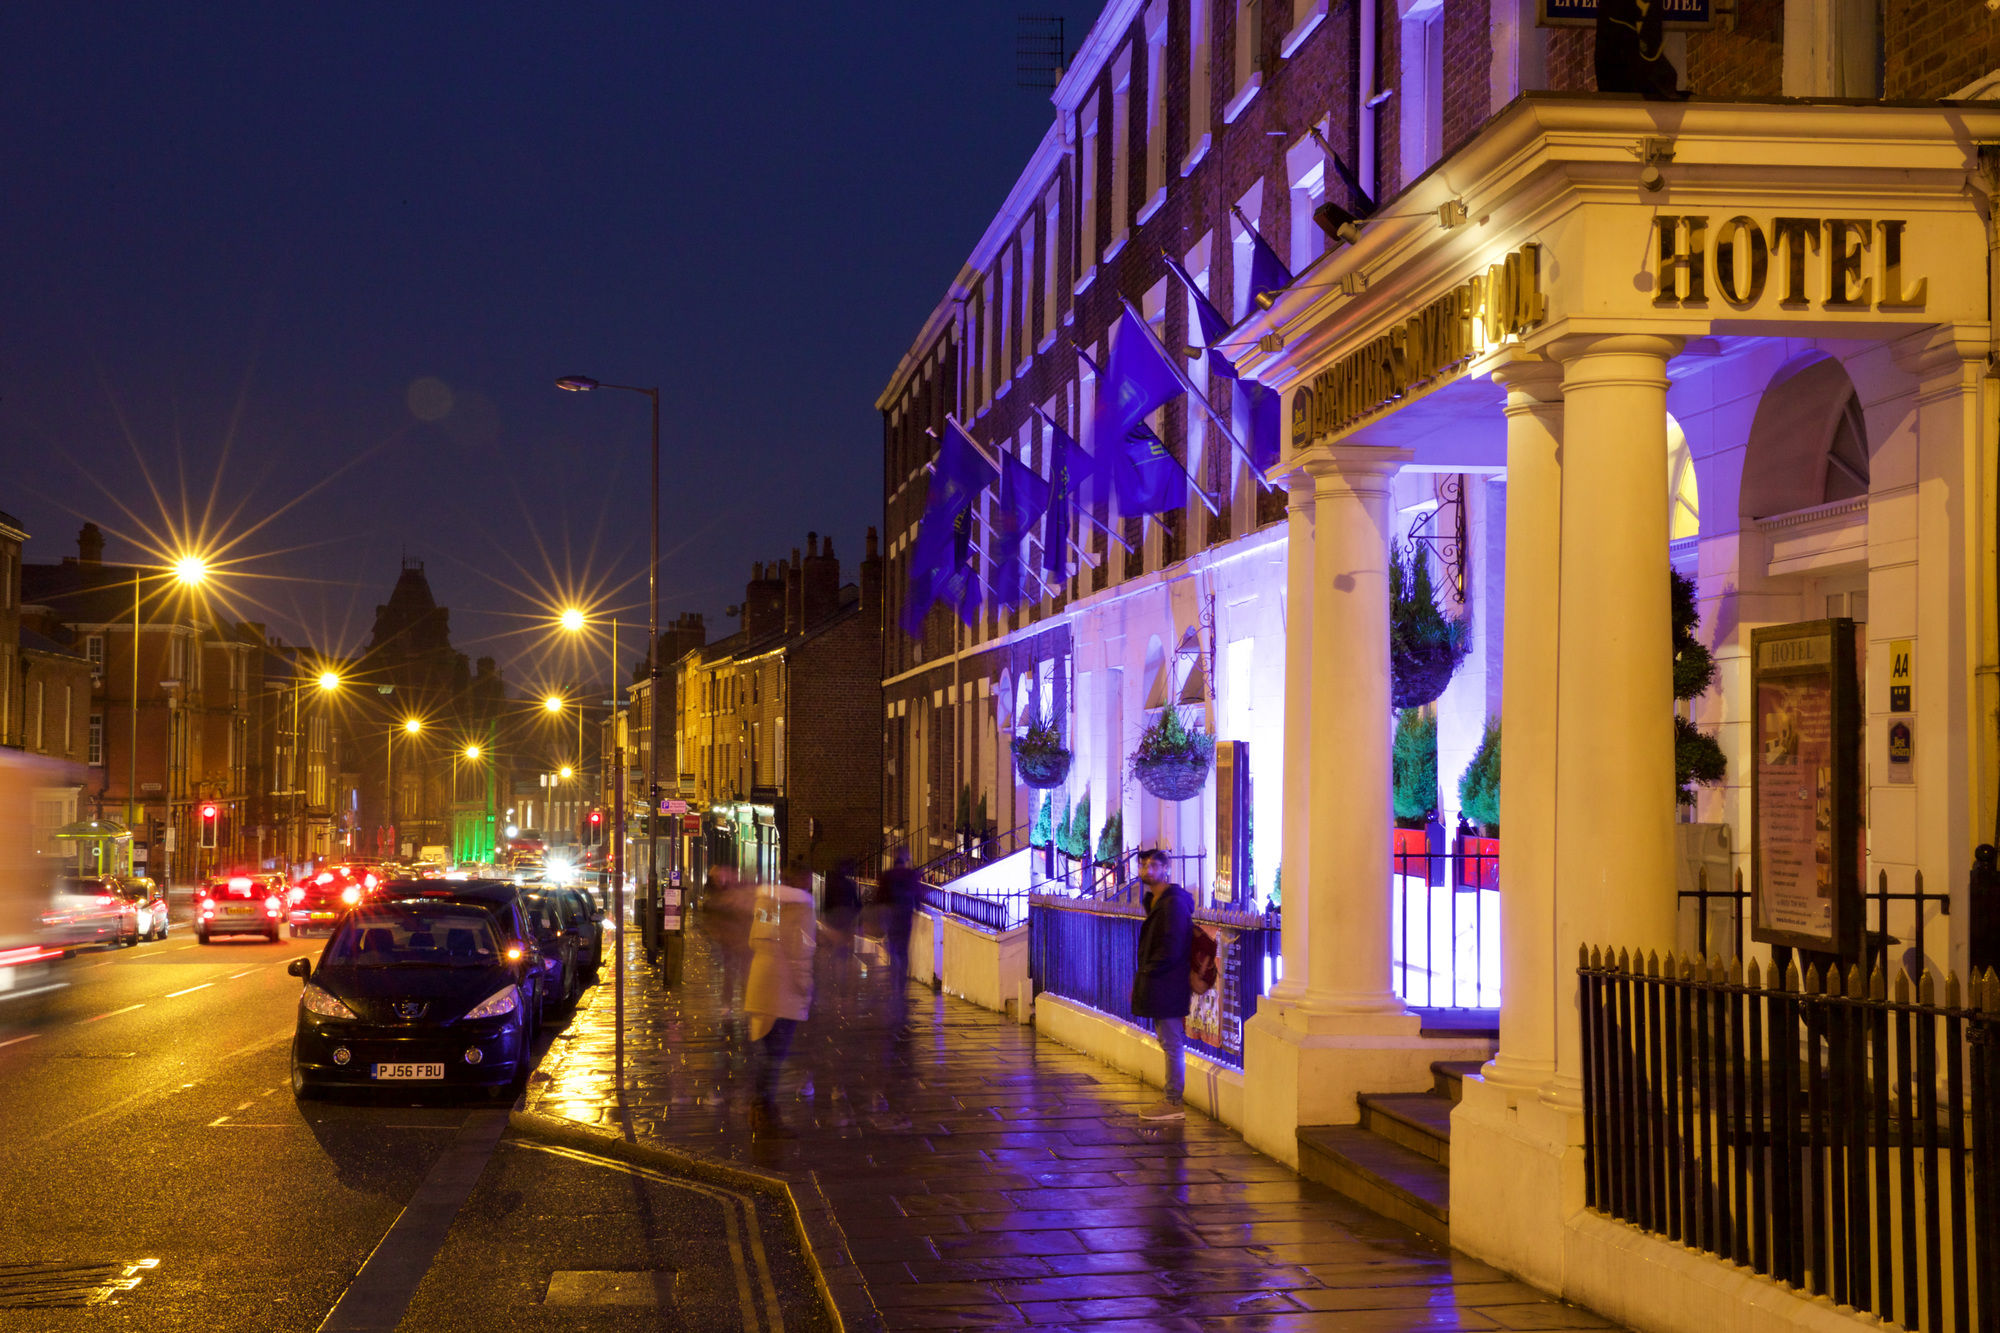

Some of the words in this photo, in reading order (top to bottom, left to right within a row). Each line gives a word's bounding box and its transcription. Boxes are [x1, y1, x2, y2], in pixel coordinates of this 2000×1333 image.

[1661, 0, 1702, 12] OTEL
[1652, 215, 1928, 310] HOTEL
[1312, 325, 1408, 440] FEATHERS
[1406, 242, 1545, 387] LIVERPOOL
[1771, 640, 1814, 663] HOTEL
[1893, 653, 1909, 679] AA
[379, 1065, 413, 1077] PJ56
[416, 1065, 442, 1077] FBU
